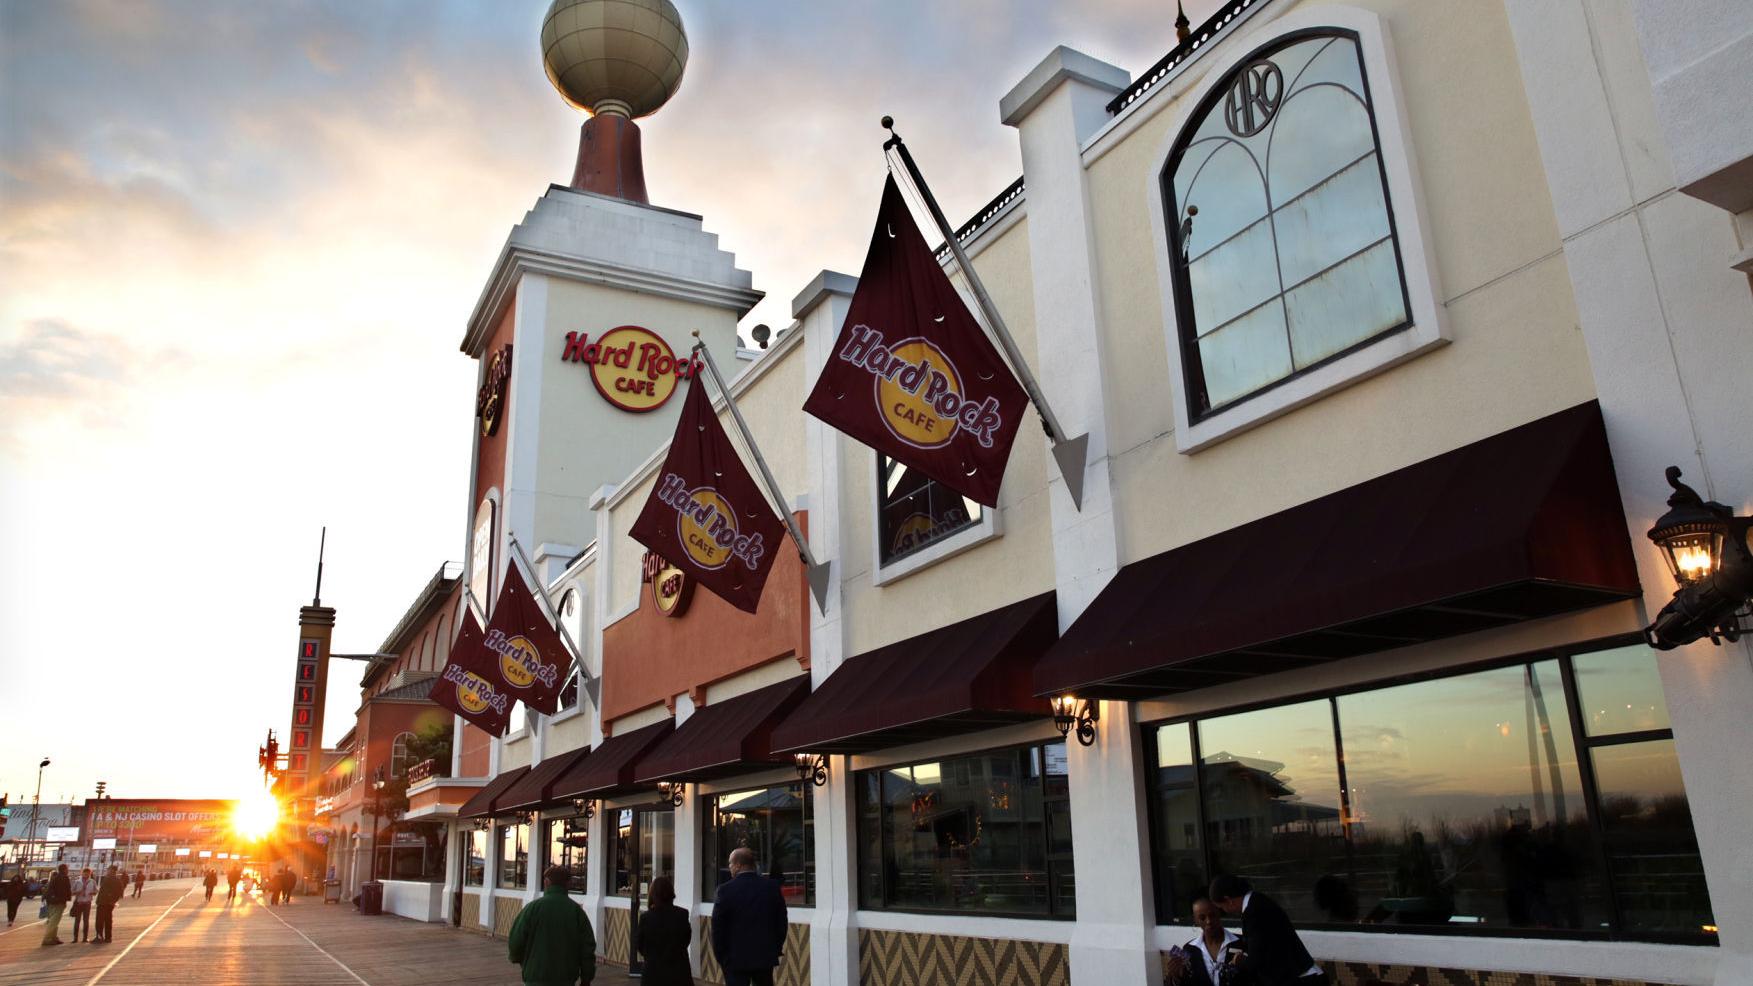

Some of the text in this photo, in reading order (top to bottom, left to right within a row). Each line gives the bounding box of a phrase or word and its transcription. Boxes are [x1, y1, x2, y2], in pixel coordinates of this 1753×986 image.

[562, 331, 705, 380] Hard Rock
[614, 376, 656, 397] CAFE
[840, 324, 1001, 447] Hard Rock
[892, 402, 936, 434] CAFE
[658, 473, 764, 571] Hard Rock
[688, 533, 715, 559] CAFE
[661, 574, 681, 598] CAFE
[484, 629, 558, 688] Hard Rock
[507, 665, 528, 681] CAFE
[443, 664, 508, 715] Hard Rock
[463, 694, 480, 708] CAFE
[115, 812, 128, 821] NJ
[130, 812, 163, 821] CASINO
[164, 812, 187, 821] SLOT
